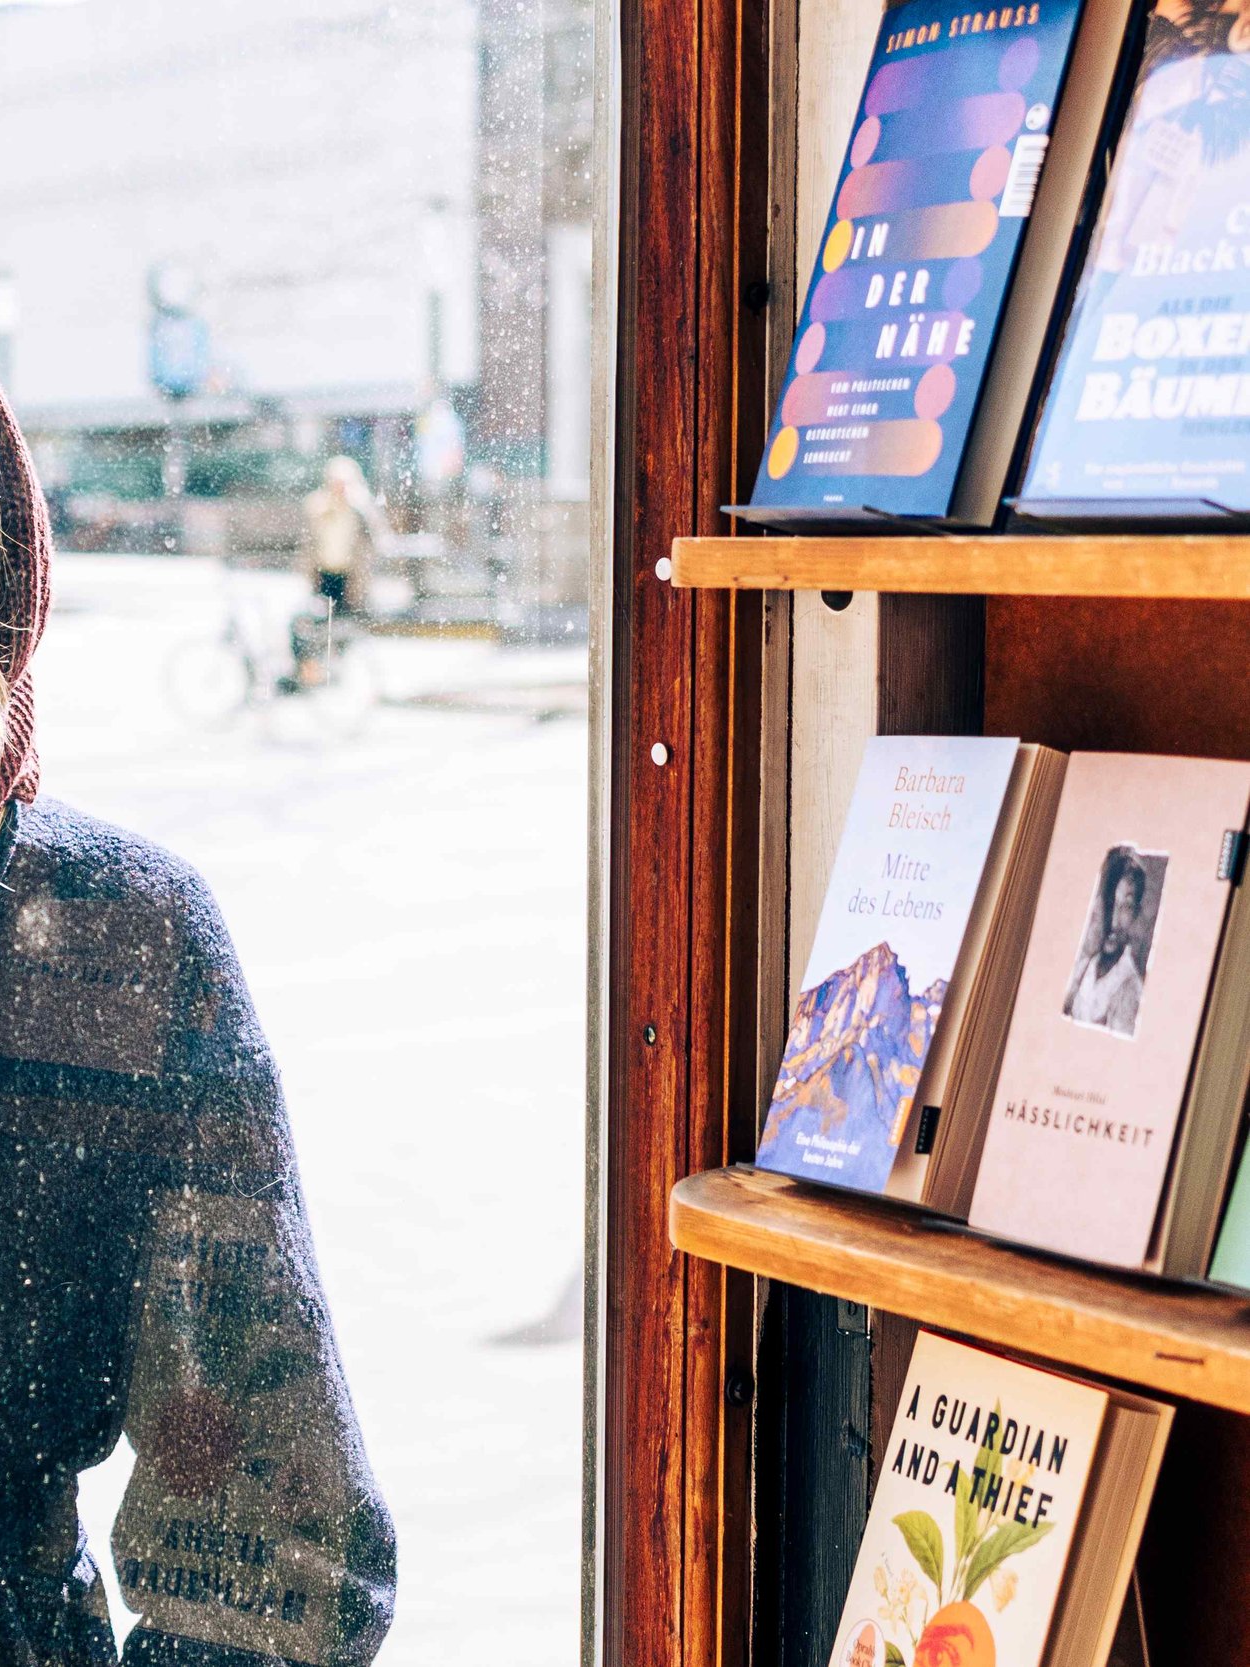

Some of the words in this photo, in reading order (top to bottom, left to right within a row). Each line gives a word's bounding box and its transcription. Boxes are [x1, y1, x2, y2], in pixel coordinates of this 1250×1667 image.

[886, 22, 941, 53] SIMON
[949, 3, 1040, 38] STRAUSS
[851, 222, 889, 259] IN
[865, 268, 930, 308] DER
[875, 312, 975, 359] NÄHE
[1092, 312, 1250, 361] BOXE
[851, 377, 910, 392] POLITISCHEN
[894, 766, 966, 794] Barbara
[888, 802, 952, 831] Bleisch
[881, 853, 931, 881] Mitte
[848, 888, 877, 915] des
[882, 890, 945, 920] Lebens
[1005, 1099, 1154, 1148] HÄSSLICHKEIT
[906, 1385, 921, 1421] A
[932, 1394, 1068, 1475] GUARDIAN
[892, 1438, 940, 1486] AND
[944, 1459, 960, 1496] A
[969, 1465, 1053, 1529] THIEF
